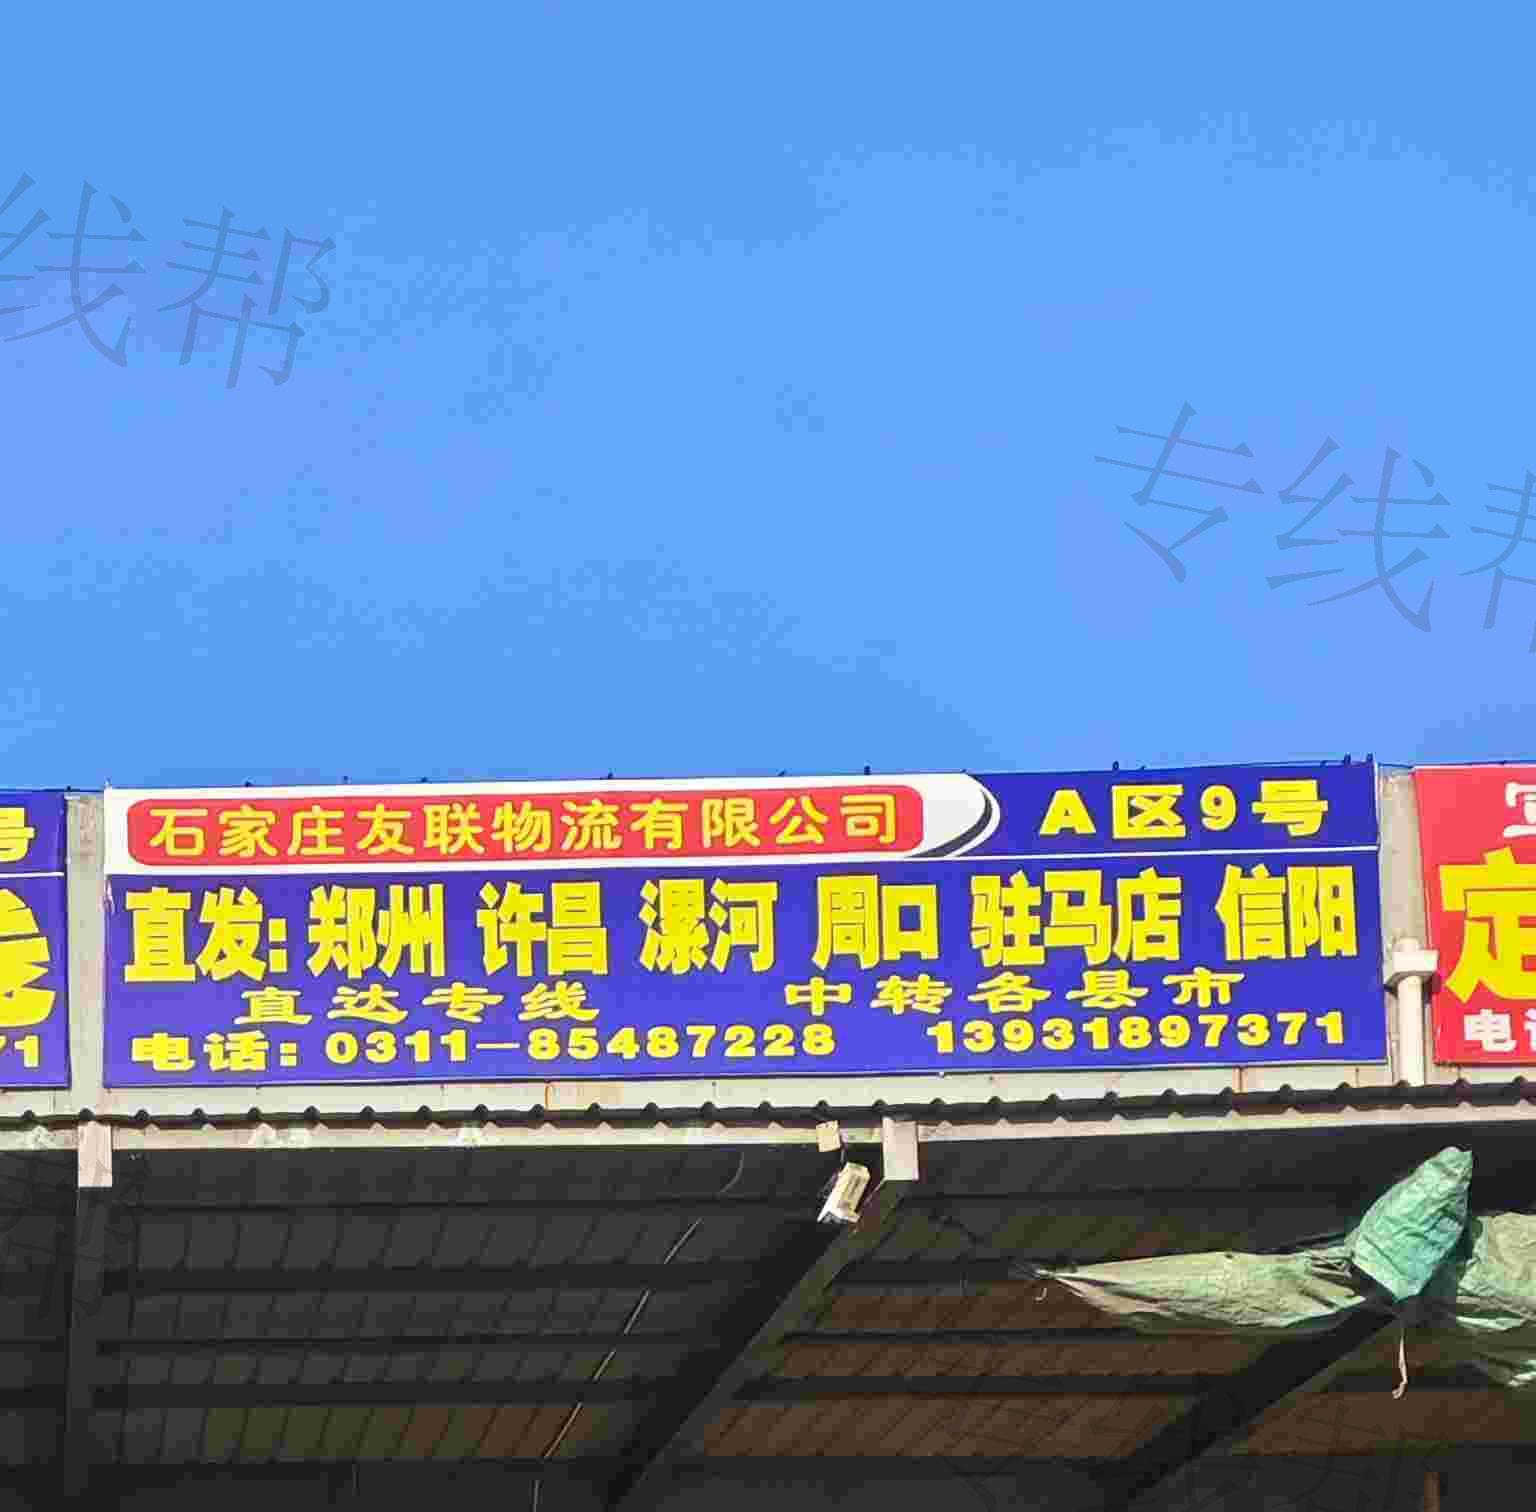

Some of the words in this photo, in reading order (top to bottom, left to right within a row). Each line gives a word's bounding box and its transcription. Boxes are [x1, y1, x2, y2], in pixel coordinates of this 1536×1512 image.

[149, 794, 897, 858] 石家庄友联物流有限公司
[1040, 779, 1329, 840] A区9号
[477, 880, 609, 977] 许昌
[639, 877, 779, 974] 漯河
[813, 874, 941, 969] 周口
[970, 867, 1183, 966] 驻马店
[1215, 864, 1358, 961] 信阳
[234, 979, 601, 1026] 直达专线
[783, 968, 1245, 1016] 中转各县市
[926, 1011, 1344, 1054] 13931897371
[1462, 1009, 1536, 1052] 电
